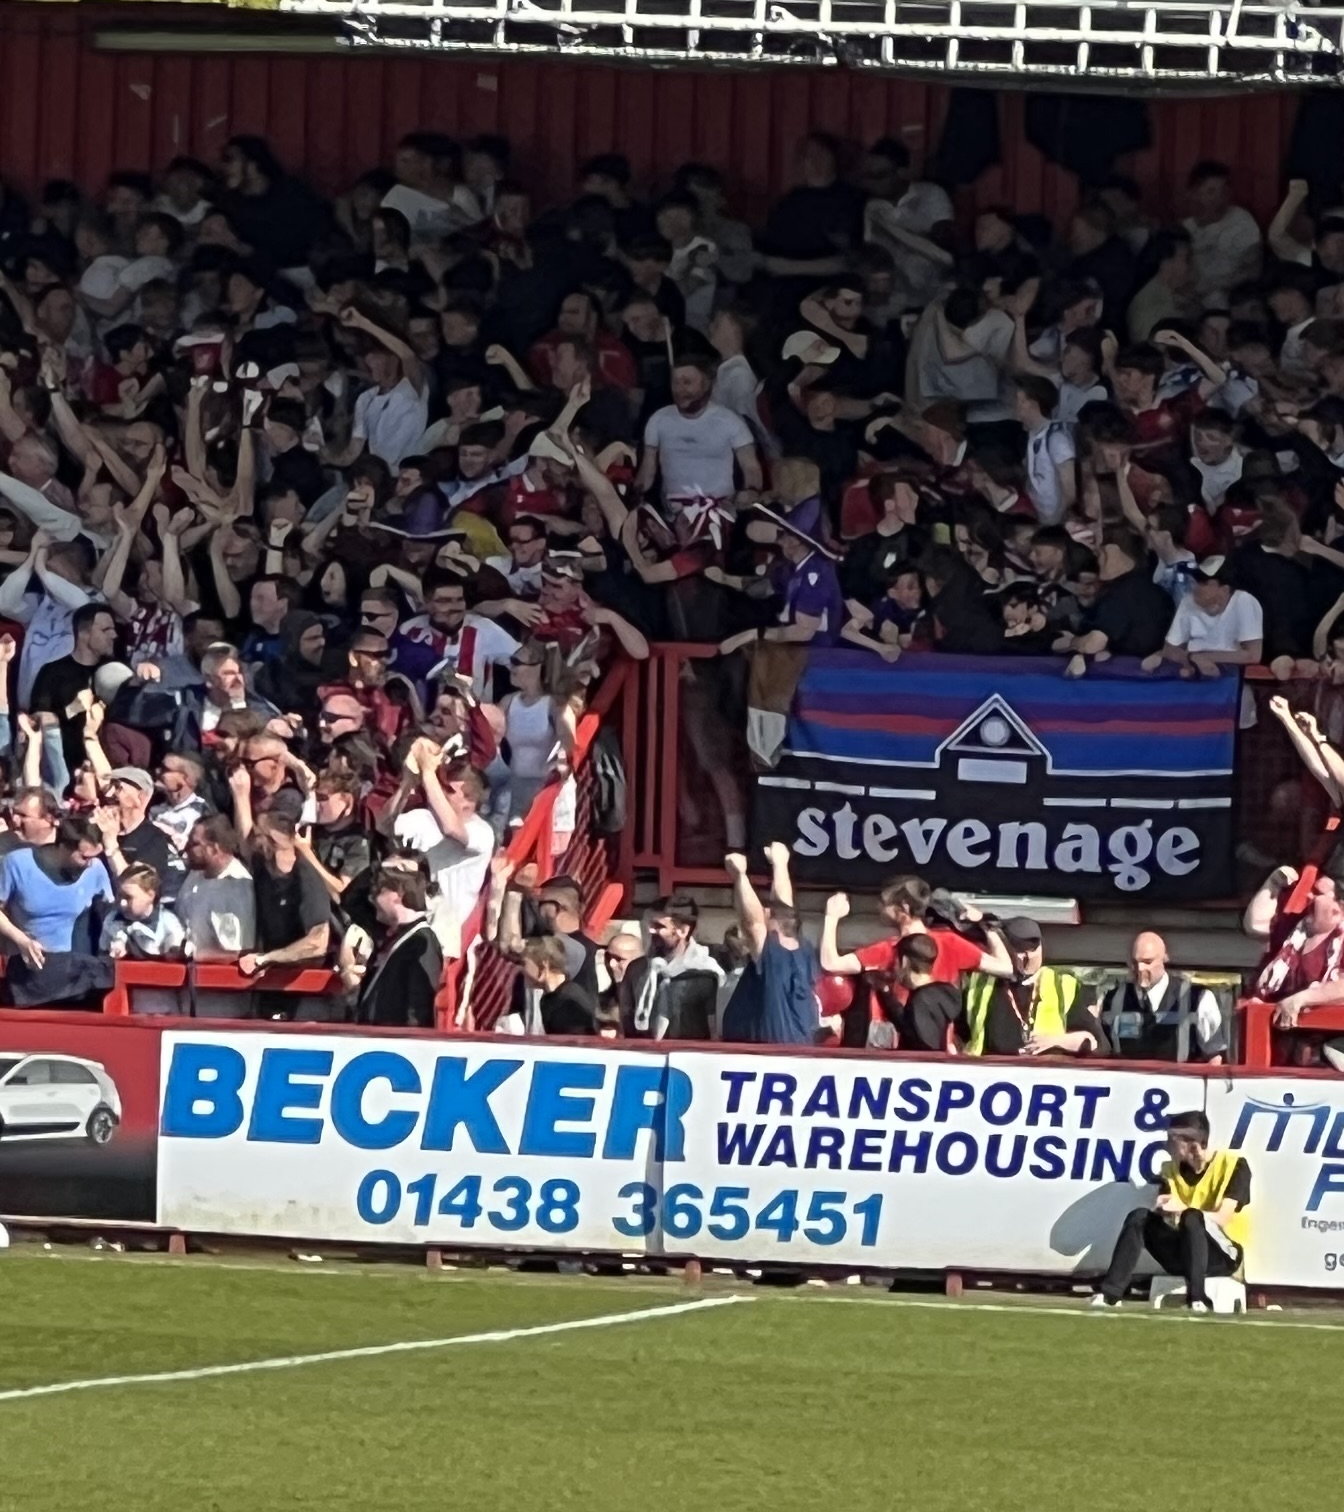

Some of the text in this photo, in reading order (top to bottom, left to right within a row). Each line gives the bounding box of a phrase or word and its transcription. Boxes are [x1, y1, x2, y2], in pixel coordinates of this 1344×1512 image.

[792, 800, 1201, 892] stevenage
[160, 1042, 693, 1163] BECKER
[720, 1071, 1171, 1133] TRANSPORT &
[356, 1170, 884, 1247] 01438 365451
